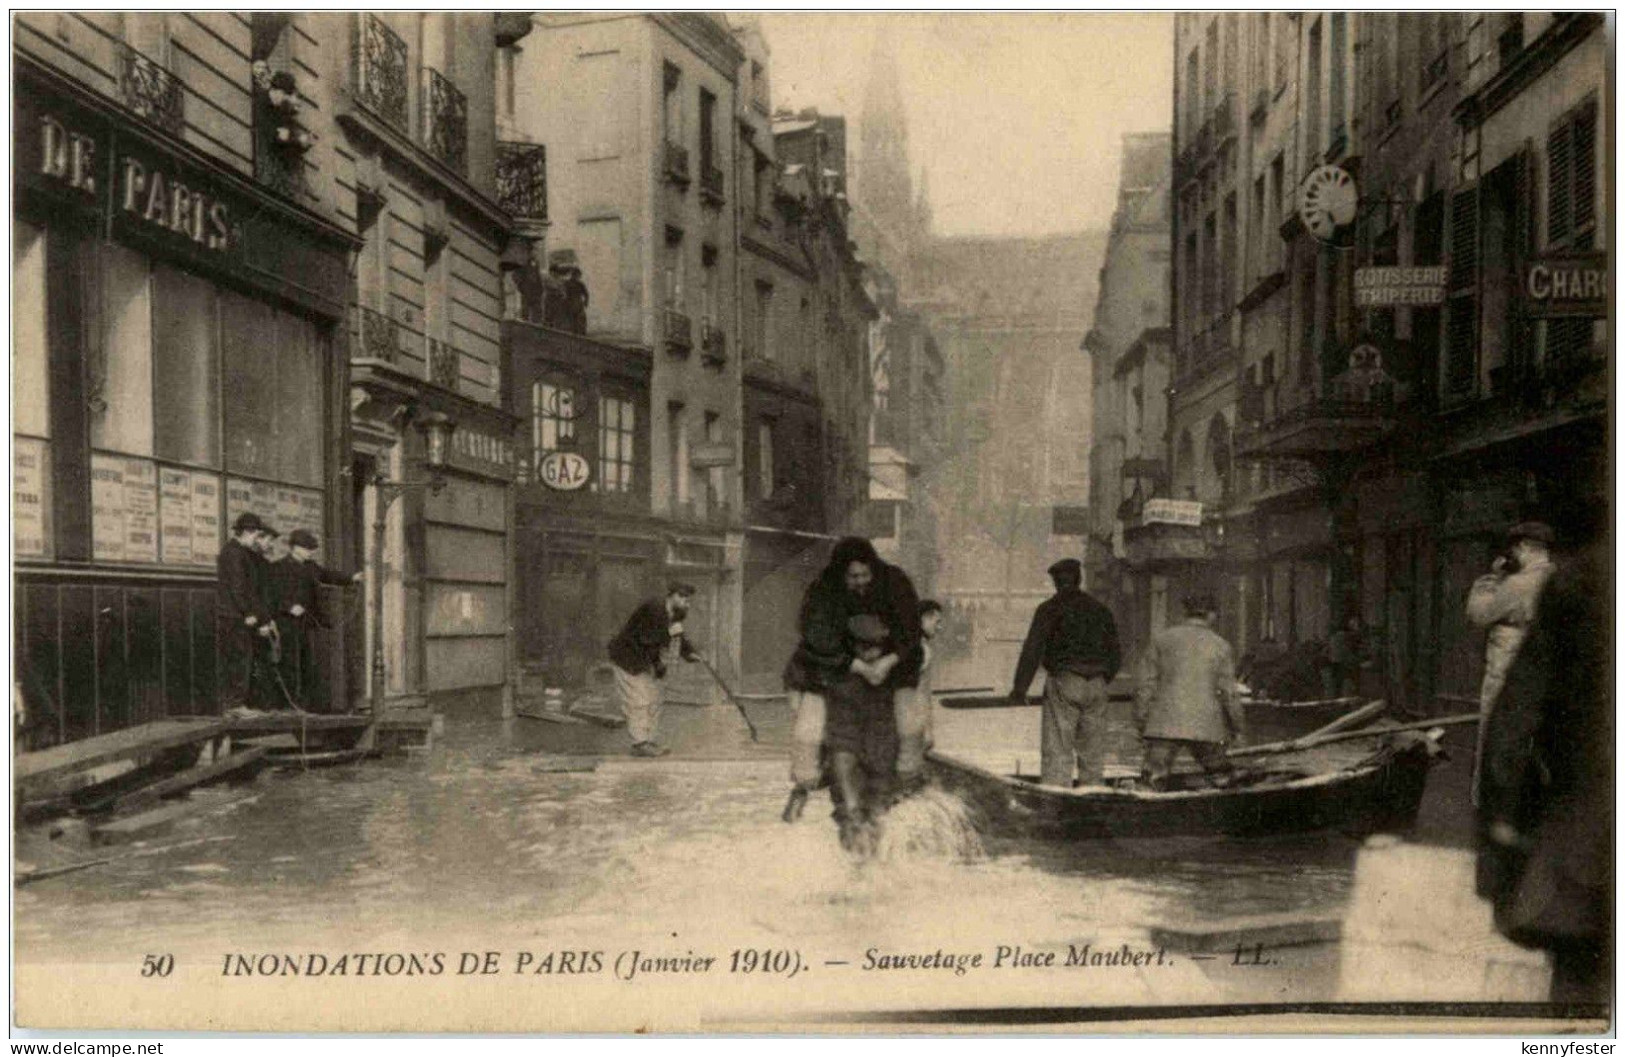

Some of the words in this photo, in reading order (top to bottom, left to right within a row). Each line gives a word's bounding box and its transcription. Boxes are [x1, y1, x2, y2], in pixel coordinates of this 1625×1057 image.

[38, 113, 96, 195] DE
[123, 156, 229, 250] PARIS
[1358, 287, 1443, 304] TRIPERIE
[545, 456, 584, 484] GAZ
